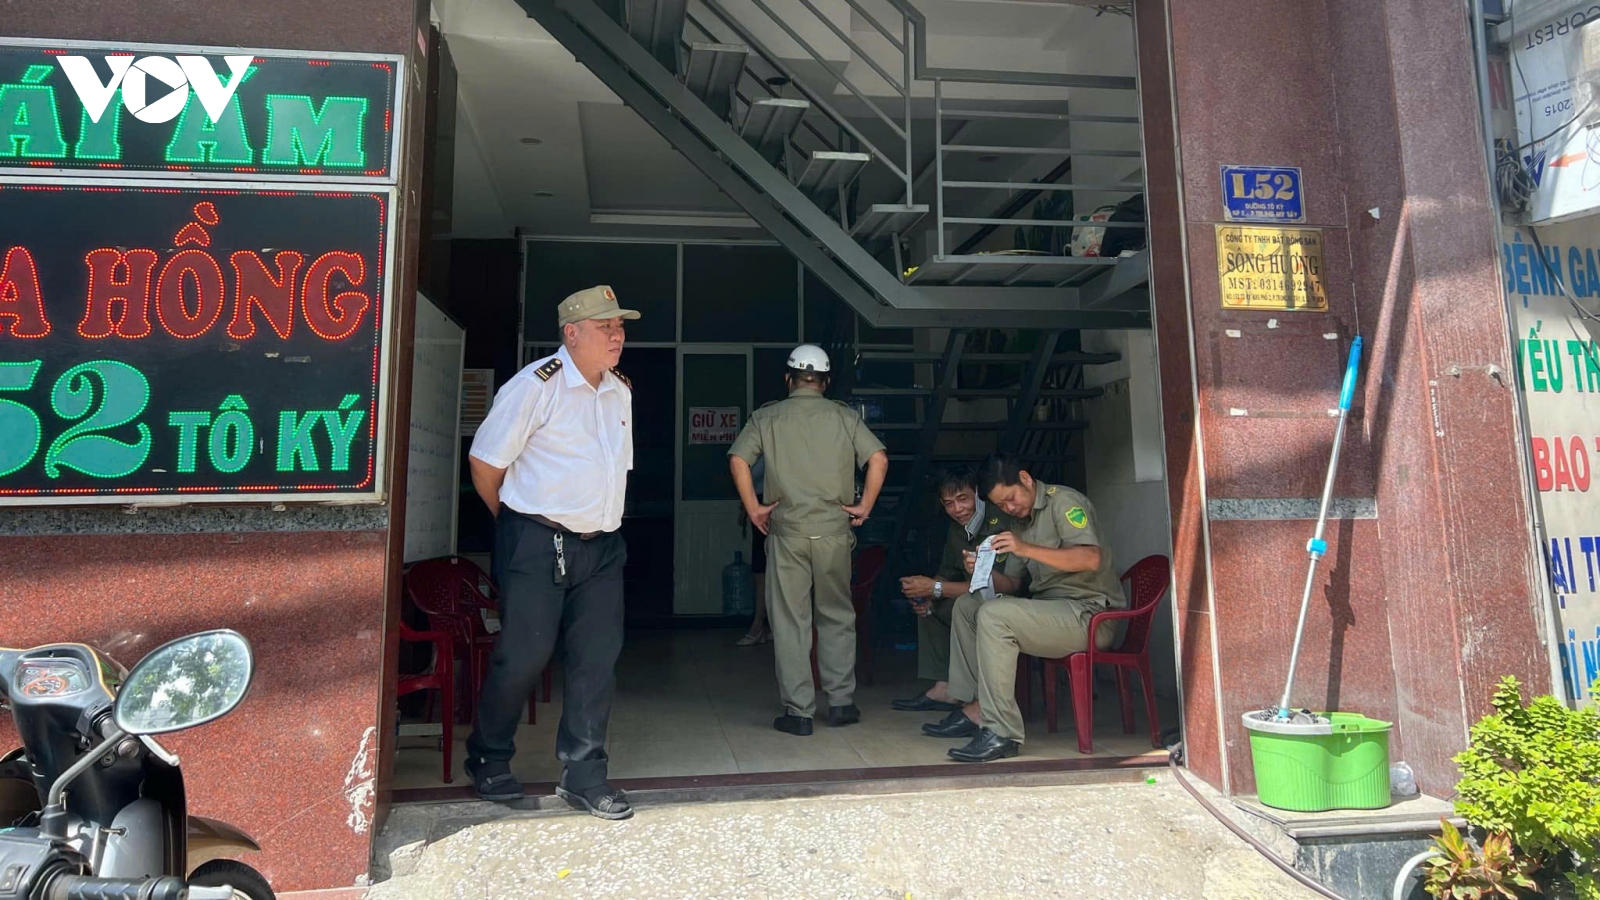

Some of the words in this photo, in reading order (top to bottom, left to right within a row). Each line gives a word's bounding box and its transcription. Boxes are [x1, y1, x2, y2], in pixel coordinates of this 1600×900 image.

[1231, 172, 1295, 201] L52
[1225, 231, 1243, 244] CÔNG
[1244, 234, 1252, 244] TY
[1254, 235, 1271, 244] TNHH
[76, 200, 371, 342] HỒNG
[1226, 246, 1265, 274] SÔNG
[1269, 250, 1319, 276] HƯƠNG
[692, 409, 716, 428] GIỮ
[720, 413, 737, 428] XE
[168, 393, 255, 475] TÔ
[275, 393, 366, 474] KÝ
[1531, 435, 1591, 493] BAO
